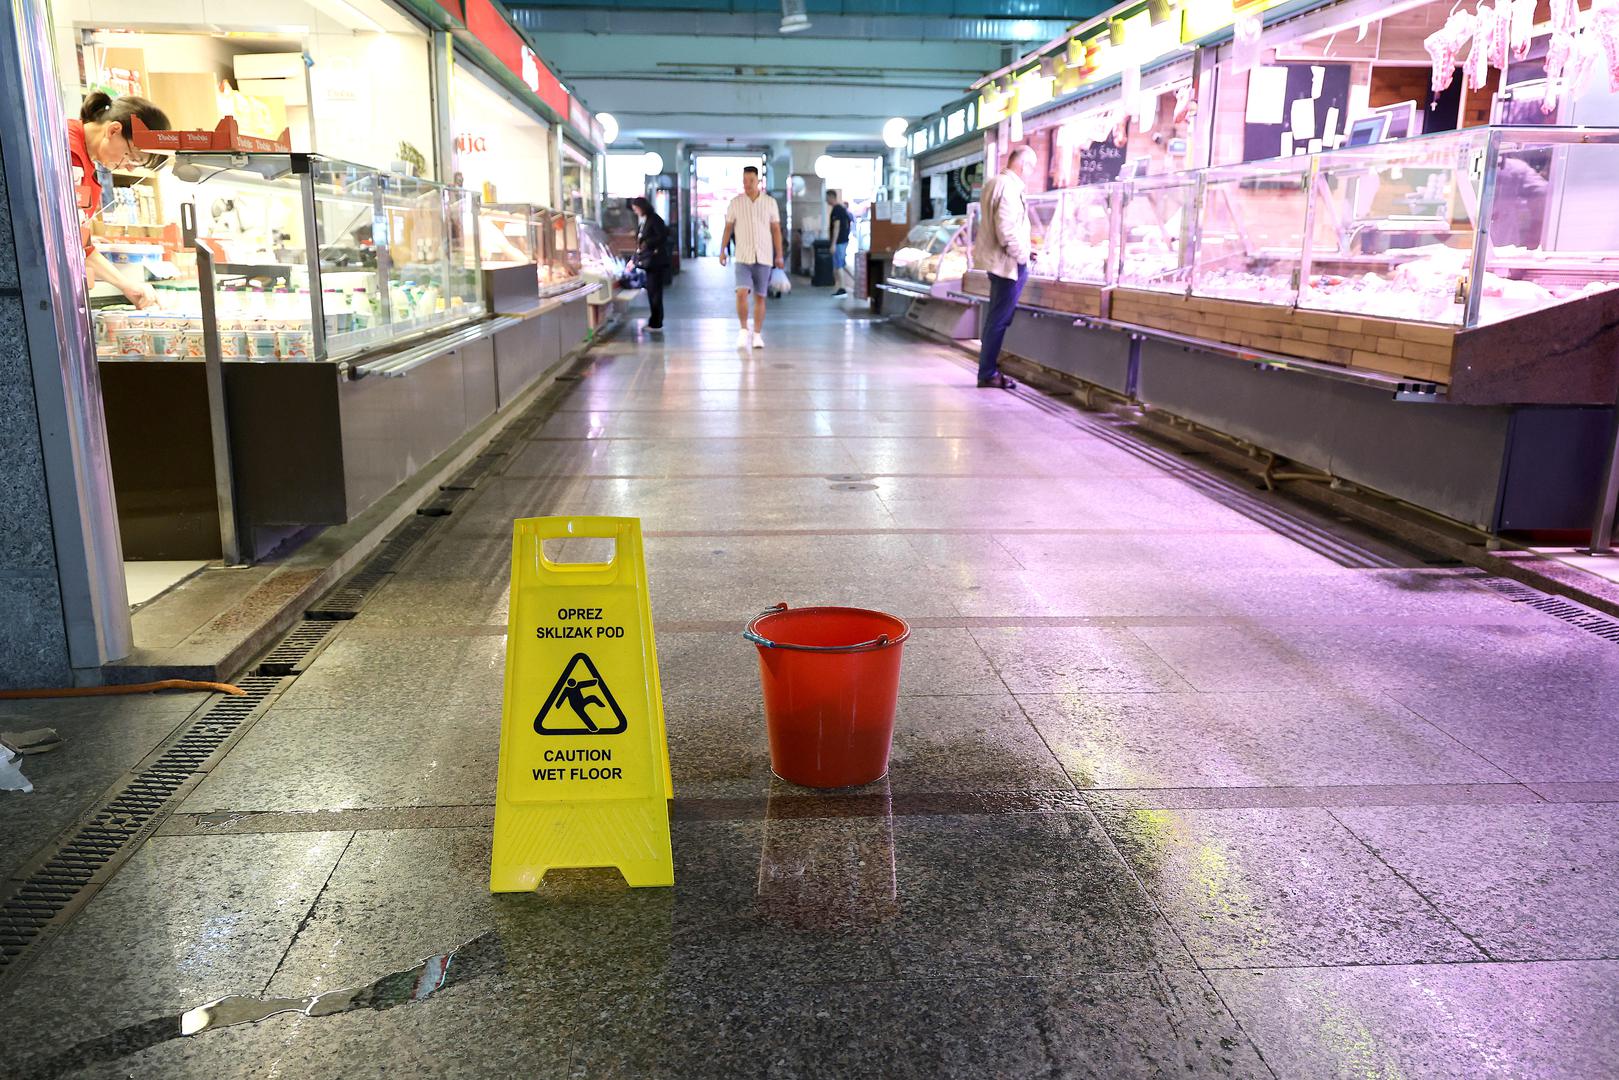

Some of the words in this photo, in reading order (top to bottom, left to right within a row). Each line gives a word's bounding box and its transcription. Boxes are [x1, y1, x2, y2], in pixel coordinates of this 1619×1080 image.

[557, 608, 604, 621] OPREZ
[536, 626, 594, 639] SKLIZAK
[596, 626, 625, 638] POD
[543, 749, 612, 762] CAUTION
[532, 768, 567, 781] WET
[570, 767, 623, 780] FLOOR
